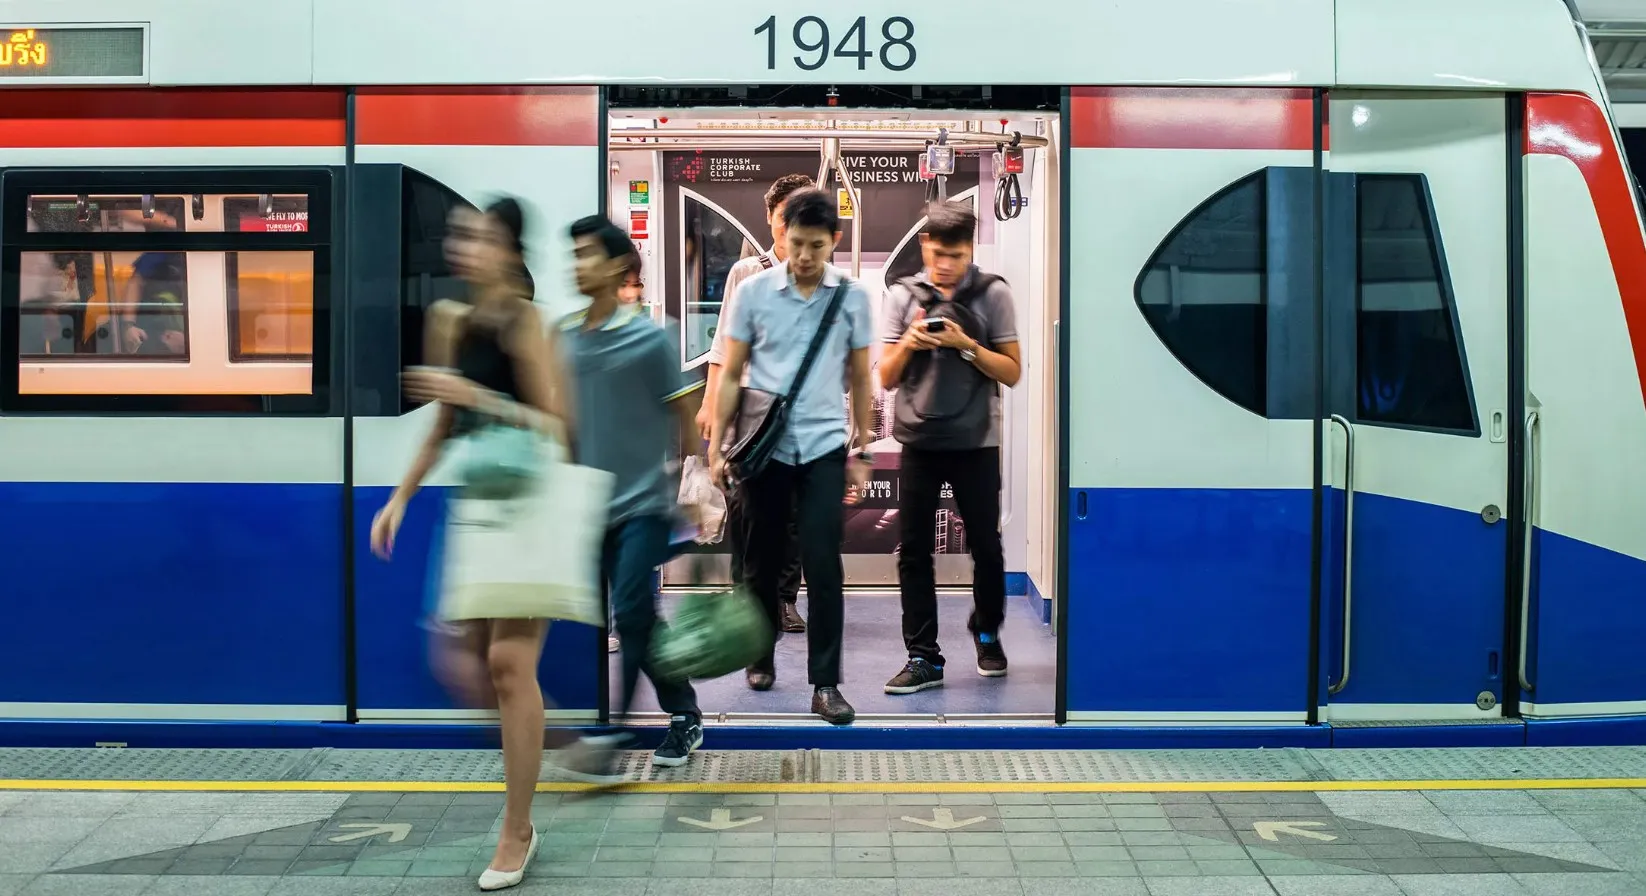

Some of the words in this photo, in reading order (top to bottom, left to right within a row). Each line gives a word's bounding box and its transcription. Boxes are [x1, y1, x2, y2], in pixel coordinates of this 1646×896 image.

[754, 15, 917, 71] 1948
[870, 156, 908, 168] YOUR
[276, 212, 286, 221] FLY
[287, 212, 295, 221] TO
[873, 481, 891, 489] YOUR
